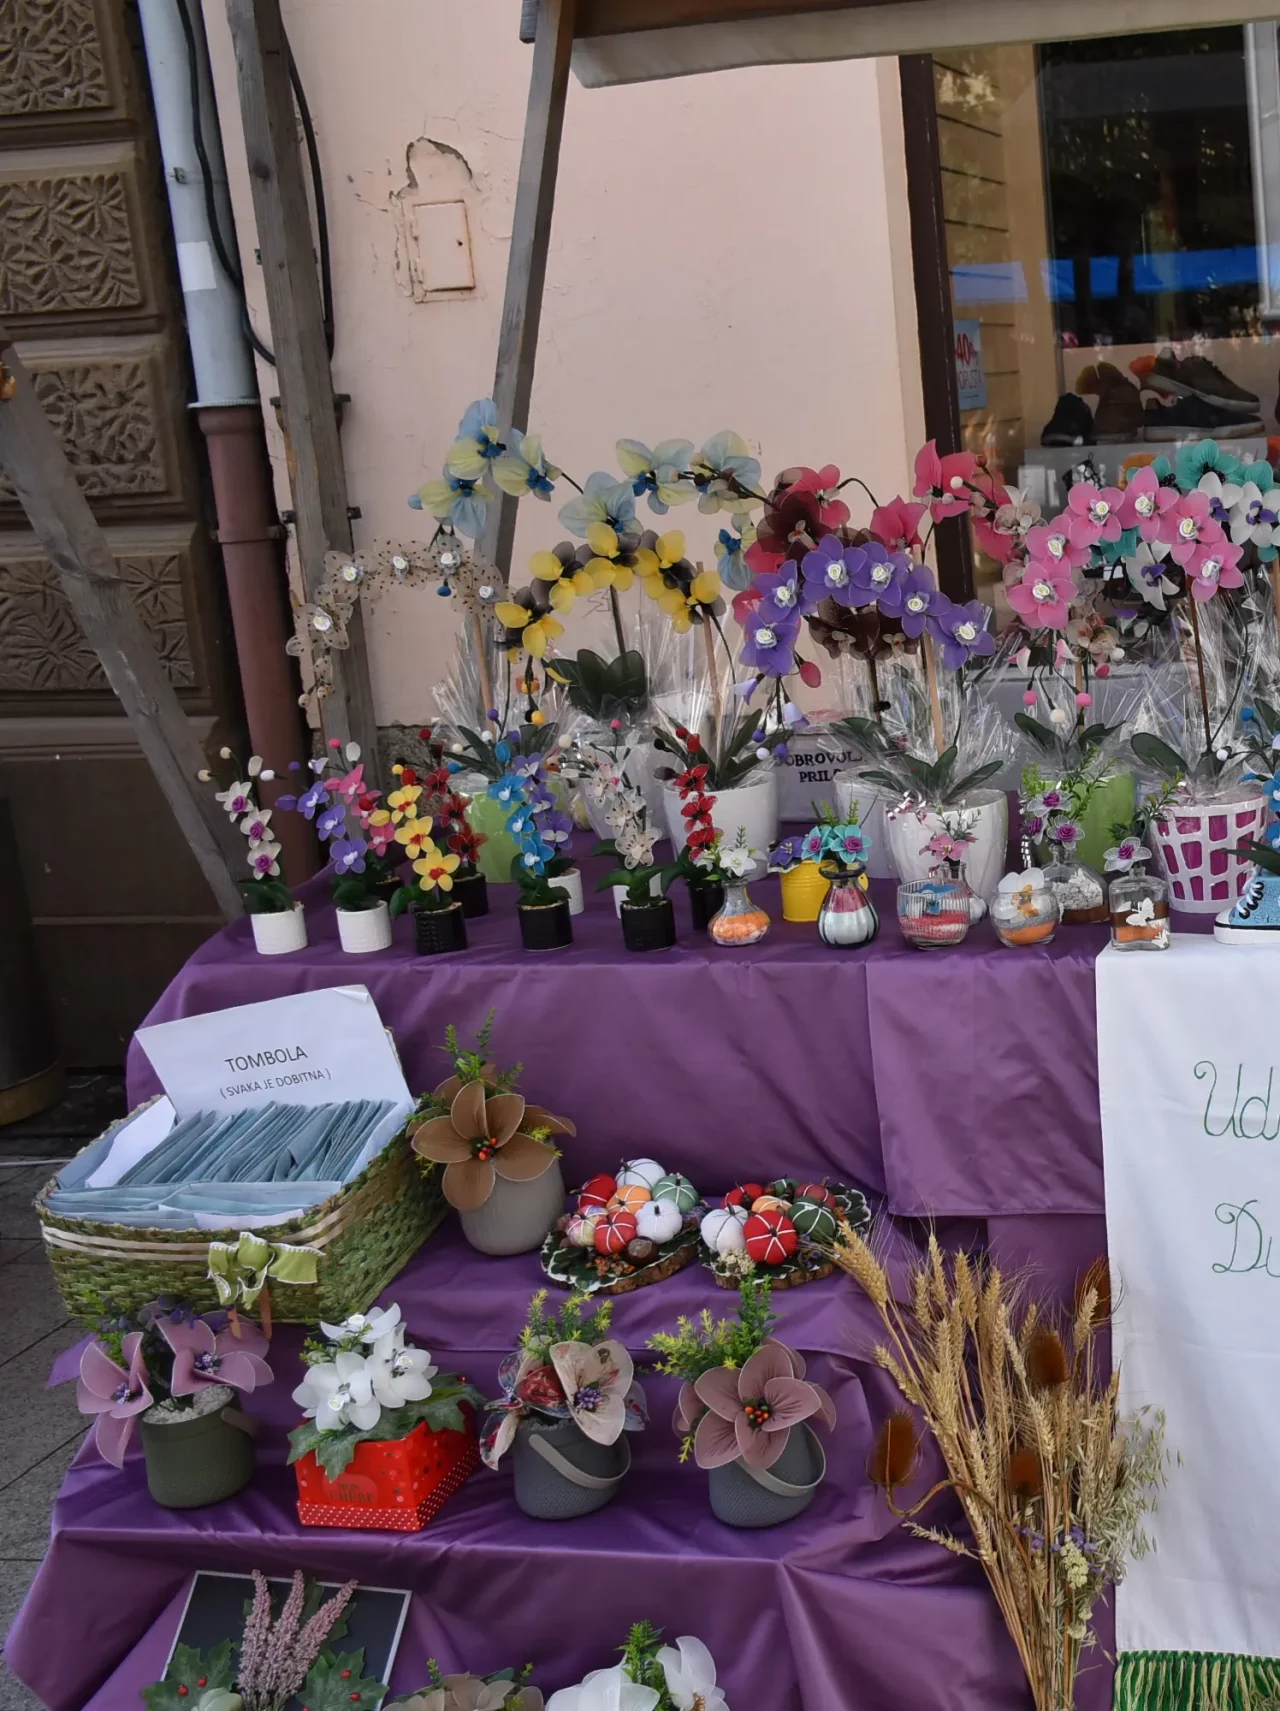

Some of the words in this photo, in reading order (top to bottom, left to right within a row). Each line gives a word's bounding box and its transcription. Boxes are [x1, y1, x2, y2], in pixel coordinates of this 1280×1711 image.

[224, 1046, 308, 1073] TOMBOLA
[226, 1081, 263, 1097] SVAKA
[264, 1079, 275, 1090] JE
[275, 1069, 325, 1087] DOBITNA
